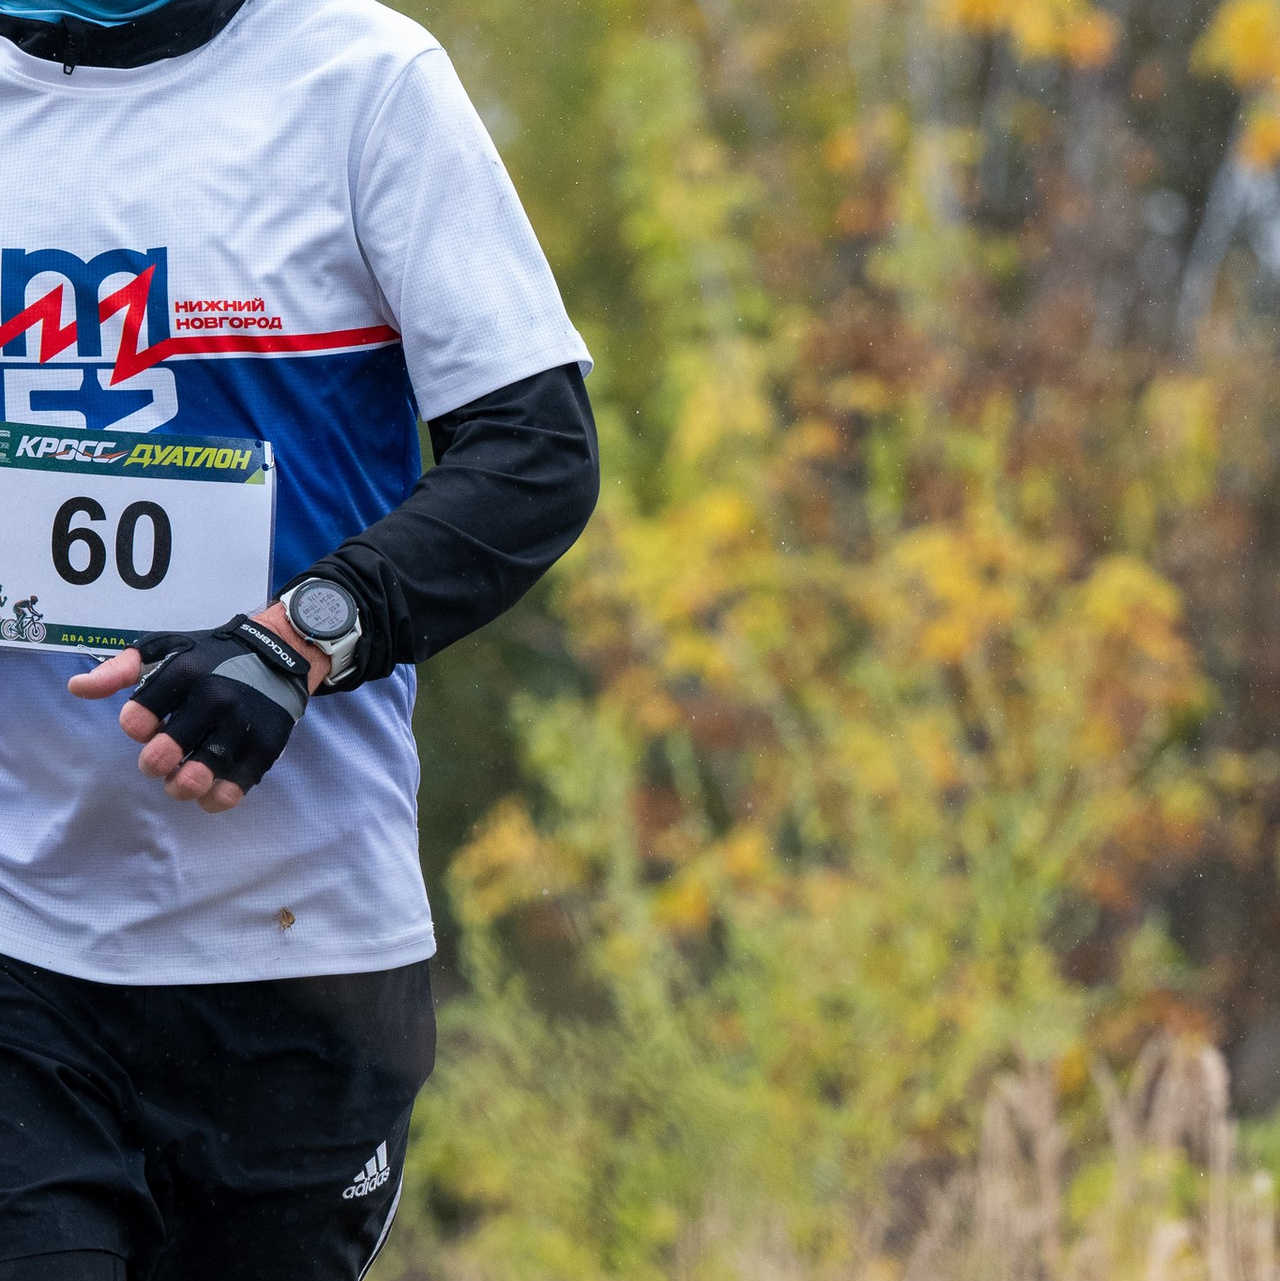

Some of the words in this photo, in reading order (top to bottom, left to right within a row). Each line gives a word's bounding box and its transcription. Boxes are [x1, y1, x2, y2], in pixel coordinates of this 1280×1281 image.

[174, 297, 265, 314] НИЖНИЙ
[175, 316, 282, 331] НОВГОРОД
[16, 435, 128, 464] КРОСС
[123, 443, 252, 469] ДУАТЛОН
[51, 496, 173, 590] 60
[61, 633, 85, 643] ДВА
[239, 623, 296, 668] ROCKBROS
[342, 1166, 391, 1199] adidas
